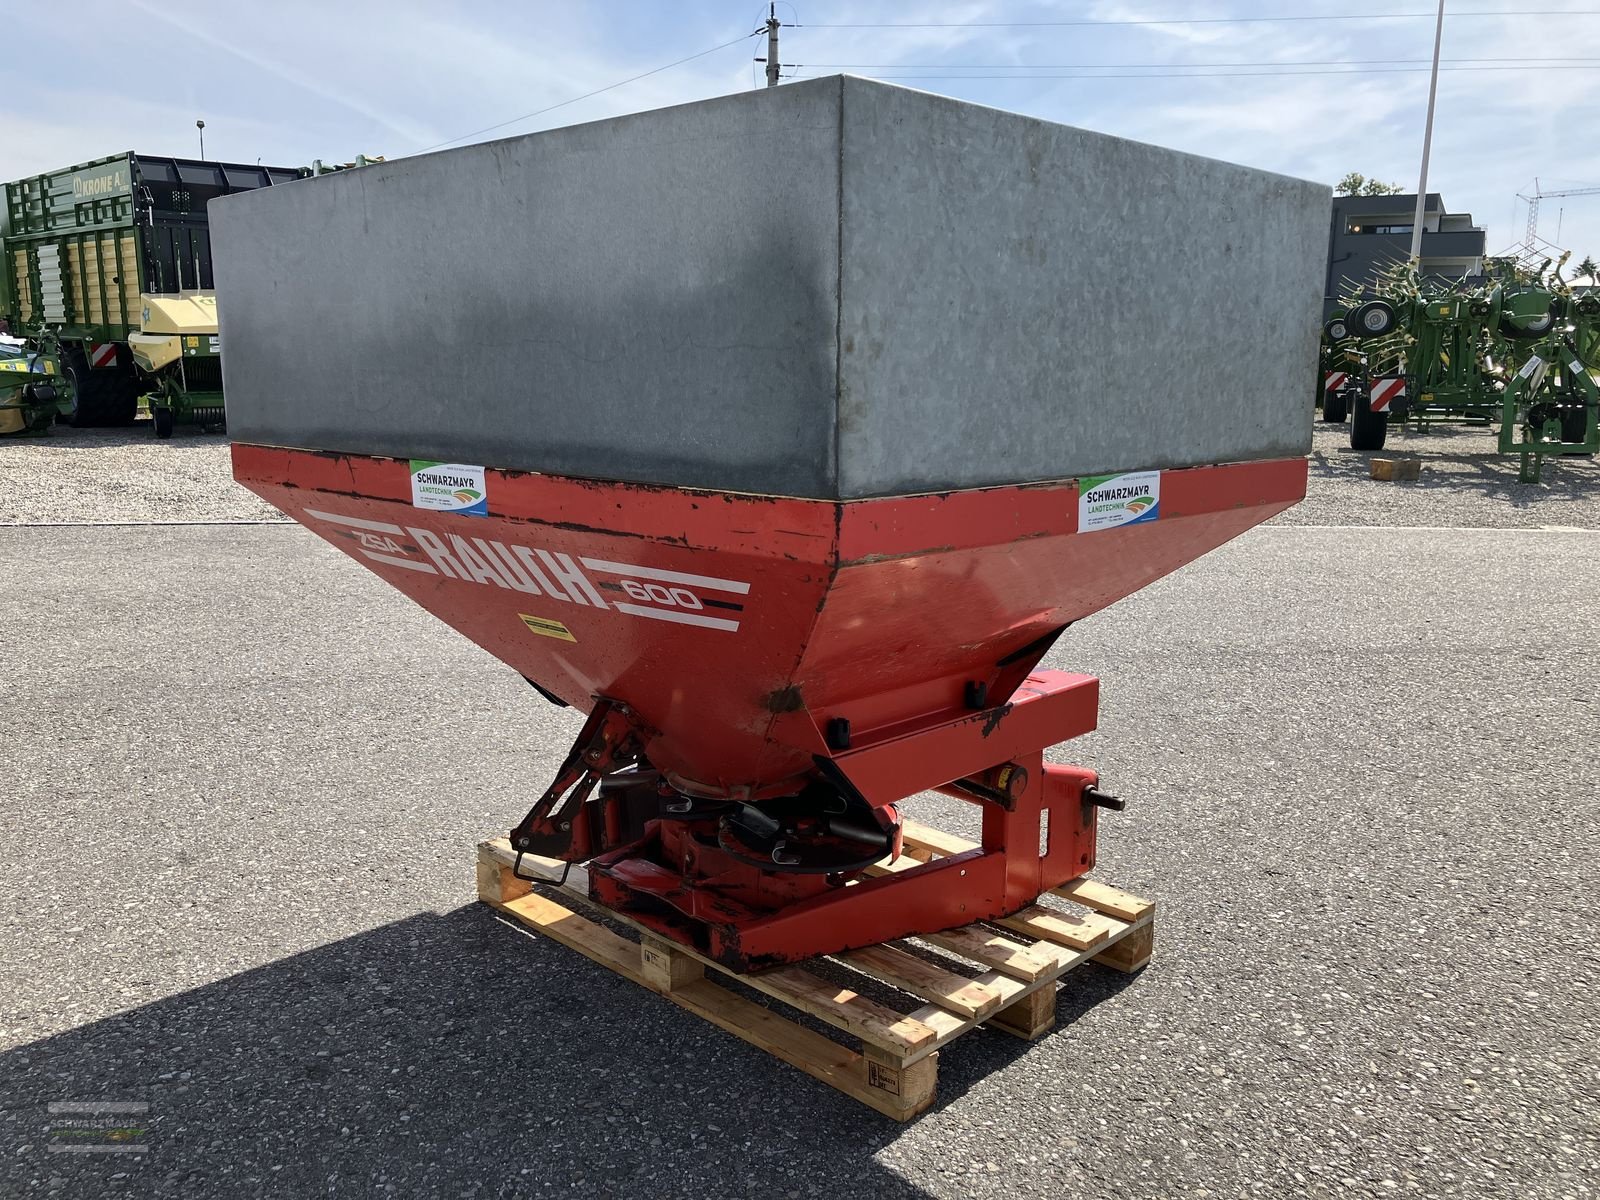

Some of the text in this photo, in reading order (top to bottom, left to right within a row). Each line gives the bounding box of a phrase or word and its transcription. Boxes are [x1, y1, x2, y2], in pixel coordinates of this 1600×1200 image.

[82, 175, 113, 197] KRONE
[417, 473, 475, 488] SCHWARZMAYR
[419, 486, 453, 496] LANDTECHNIK
[1086, 485, 1149, 503] SCHWARZMAYR
[1087, 502, 1126, 514] LANDTECHNIK
[351, 526, 704, 610] ZSA RAUCH 600
